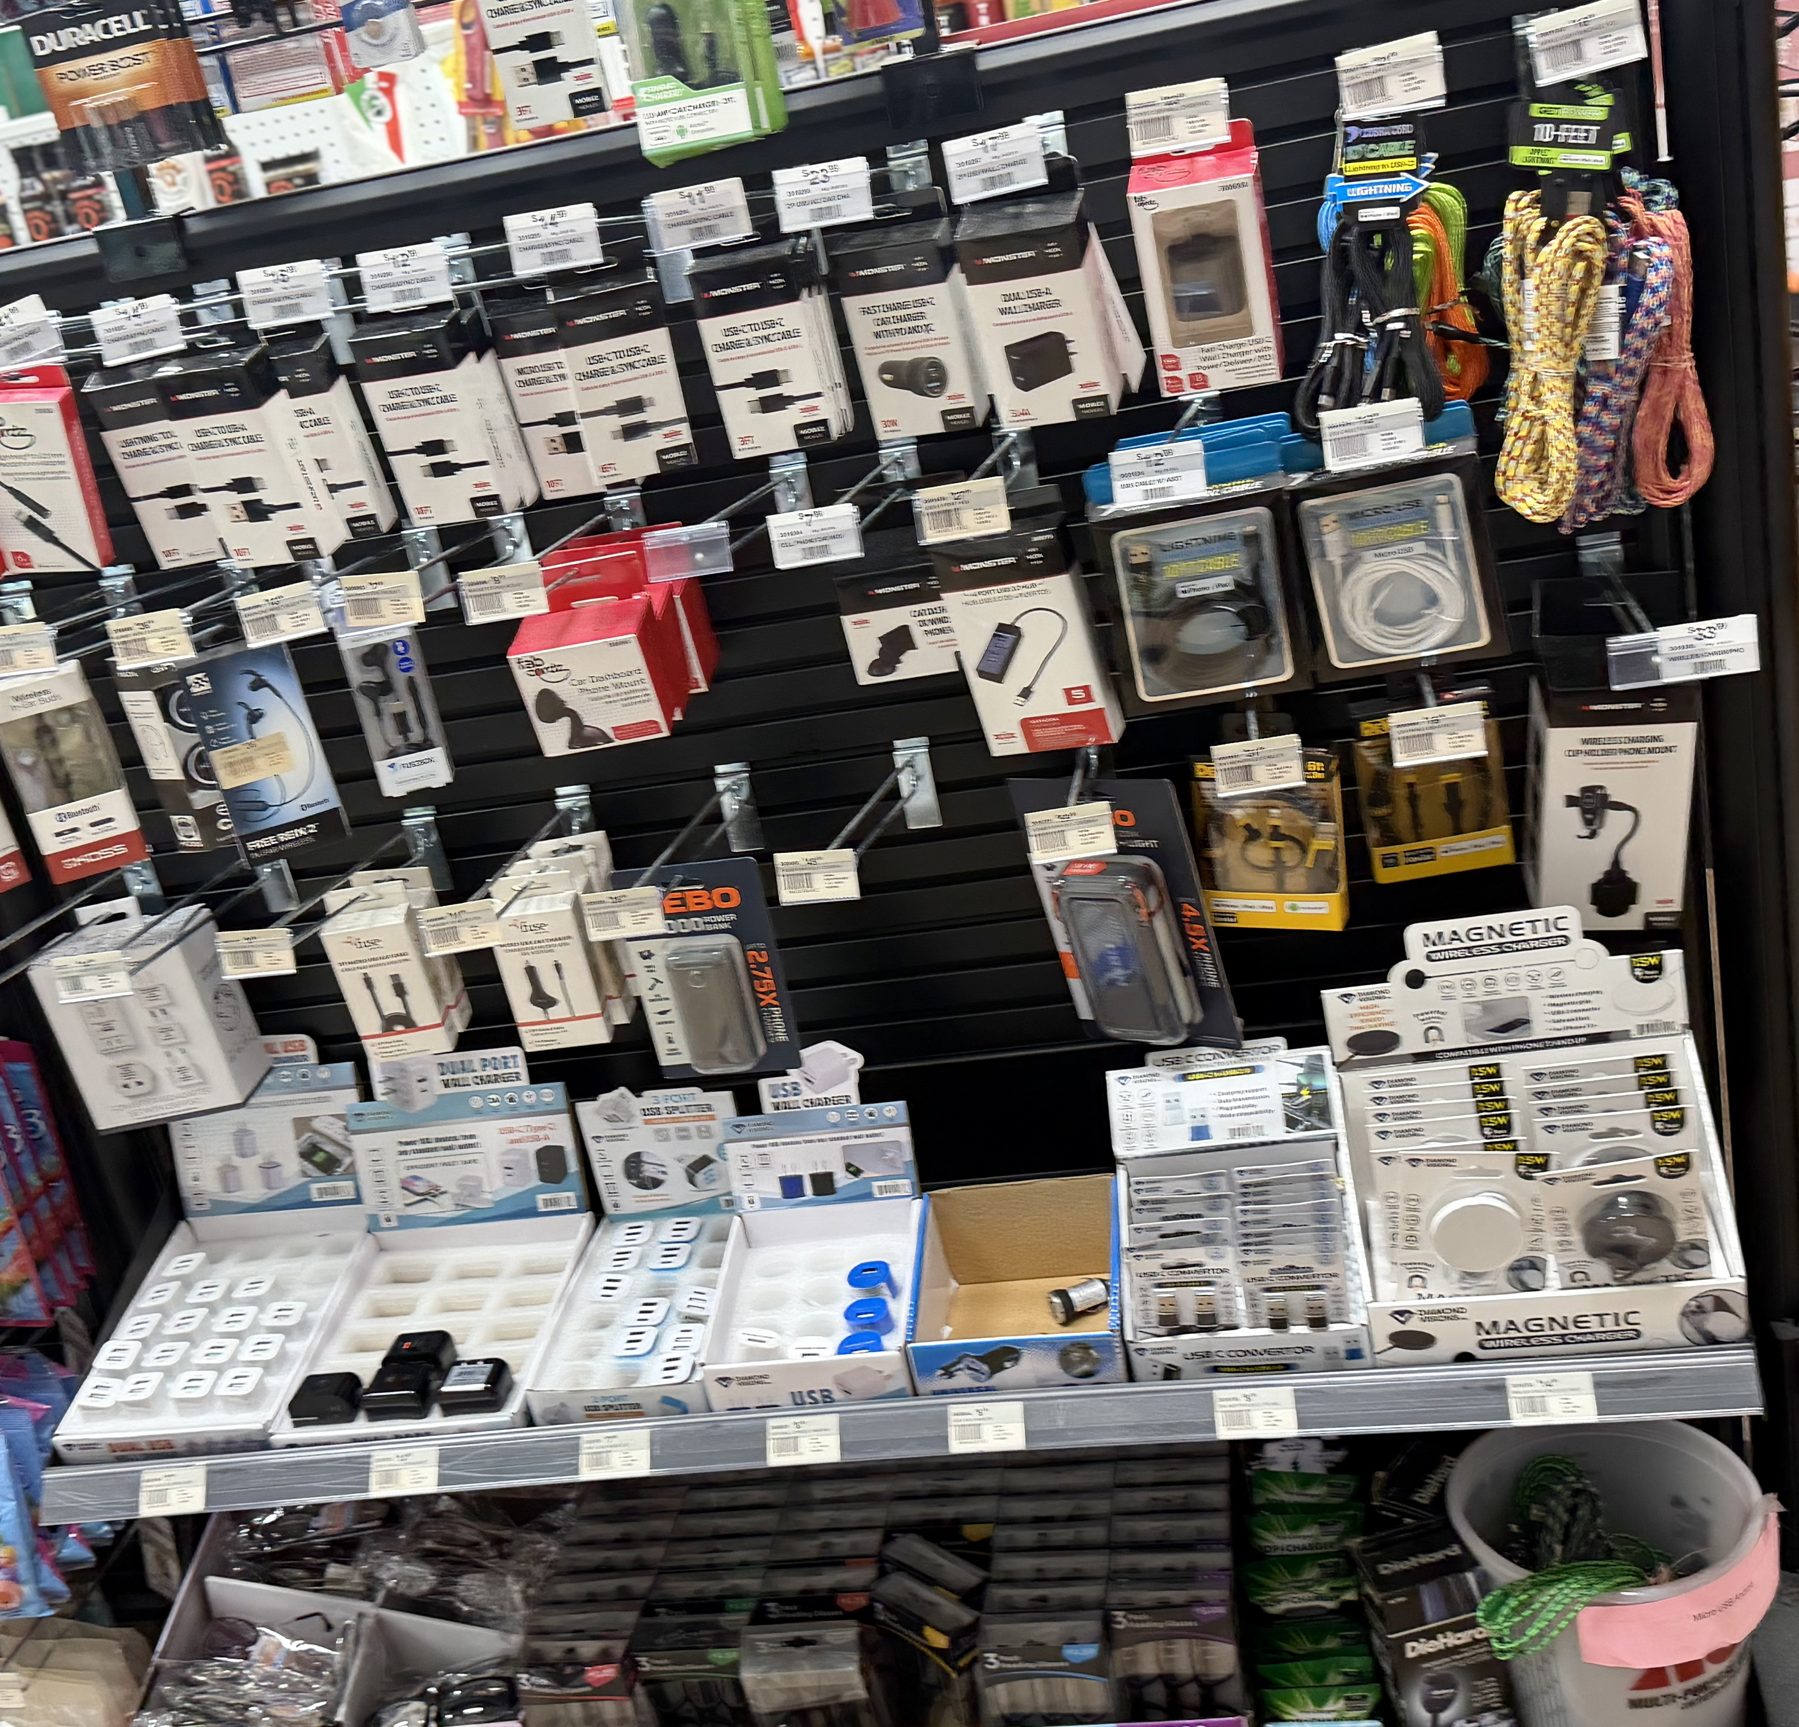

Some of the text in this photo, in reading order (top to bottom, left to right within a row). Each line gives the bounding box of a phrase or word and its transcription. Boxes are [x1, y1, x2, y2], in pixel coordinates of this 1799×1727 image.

[29, 10, 152, 56] DURACELL
[1347, 185, 1413, 197] LIGHTNING
[982, 250, 1037, 265] MONSTER
[858, 263, 905, 277] MONSTER
[712, 282, 761, 298] MONSTER
[575, 308, 629, 325] MONSTER
[512, 327, 558, 339] MONSTER
[372, 351, 418, 362] MONSTER
[960, 556, 1018, 572] MONSTER
[875, 582, 921, 595] MONSTER
[1623, 735, 1664, 744] CHARGING
[67, 803, 100, 819] Bluetooth
[703, 914, 737, 924] POWER
[705, 922, 732, 931] BANK
[1421, 916, 1570, 948] MAGNETIC
[1429, 936, 1569, 961] WIRELESS CHARGER
[771, 1007, 789, 1042] PHONE
[472, 1072, 522, 1085] CHARGER
[803, 1095, 852, 1107] CHARGER
[1417, 1307, 1467, 1316] DIAMOND
[1475, 1311, 1641, 1336] MAGNETIC
[1482, 1330, 1639, 1349] WIRELESS CHARGER
[1227, 1345, 1316, 1358] CONVERTOR
[789, 1388, 835, 1405] USB
[1377, 1544, 1462, 1574] DieHard
[1110, 1611, 1128, 1629] 3
[1404, 1627, 1489, 1658] DieHard
[984, 1652, 1000, 1669] 3
